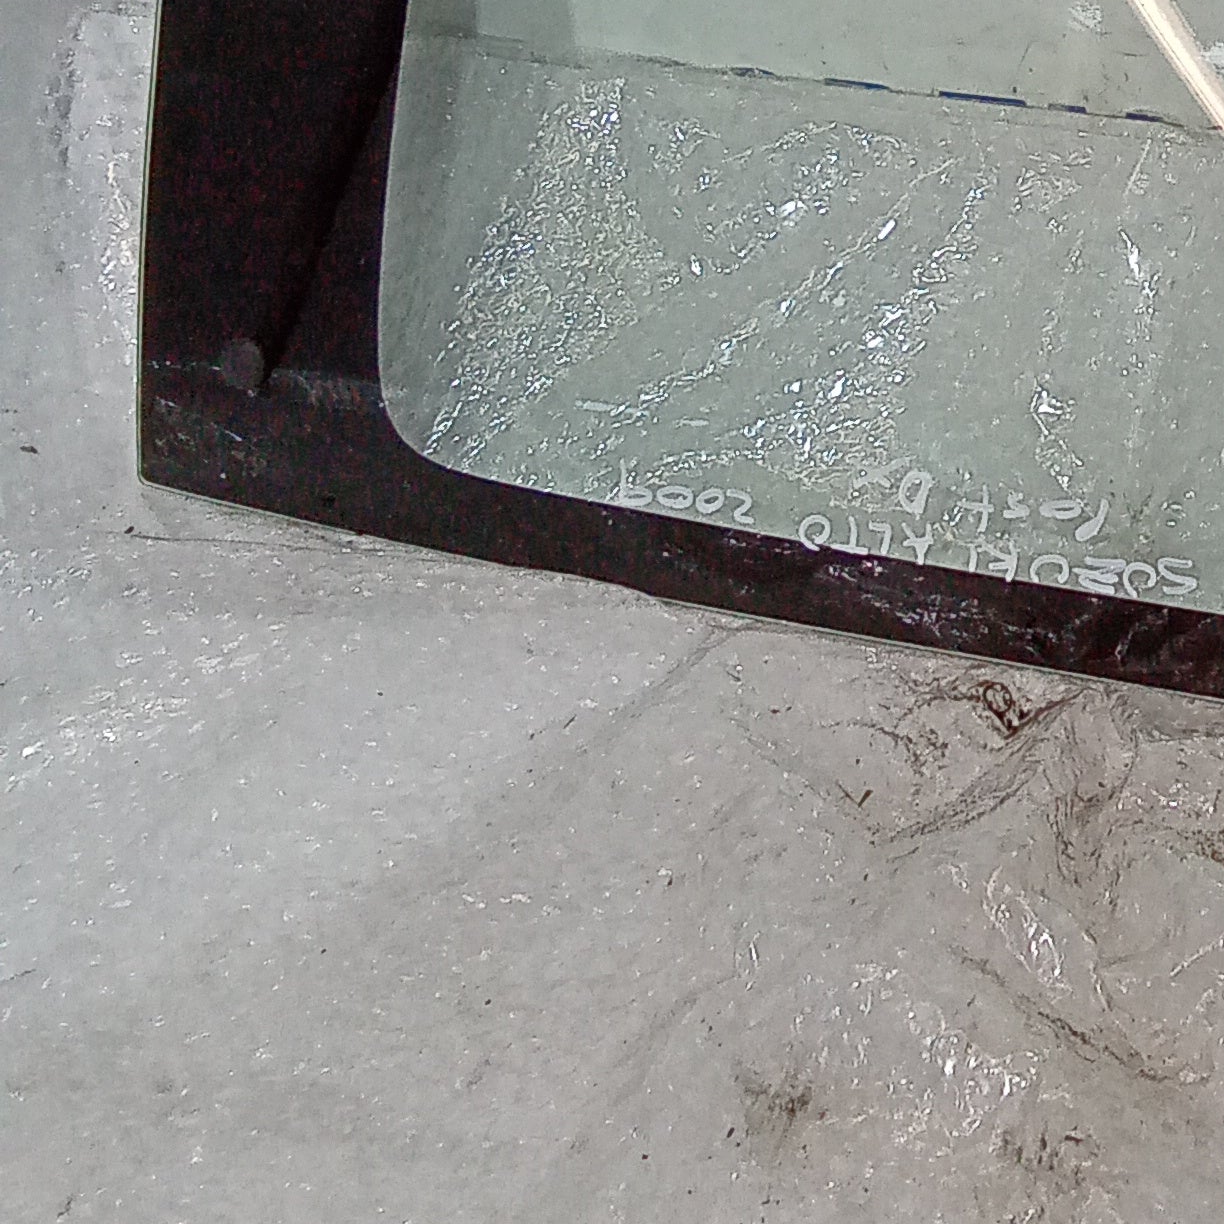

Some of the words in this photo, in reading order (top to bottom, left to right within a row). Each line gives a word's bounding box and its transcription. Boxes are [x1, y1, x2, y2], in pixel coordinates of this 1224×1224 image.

[617, 457, 755, 525] 2009
[798, 513, 934, 565] ALTO
[959, 537, 1198, 598] SUZUKI
